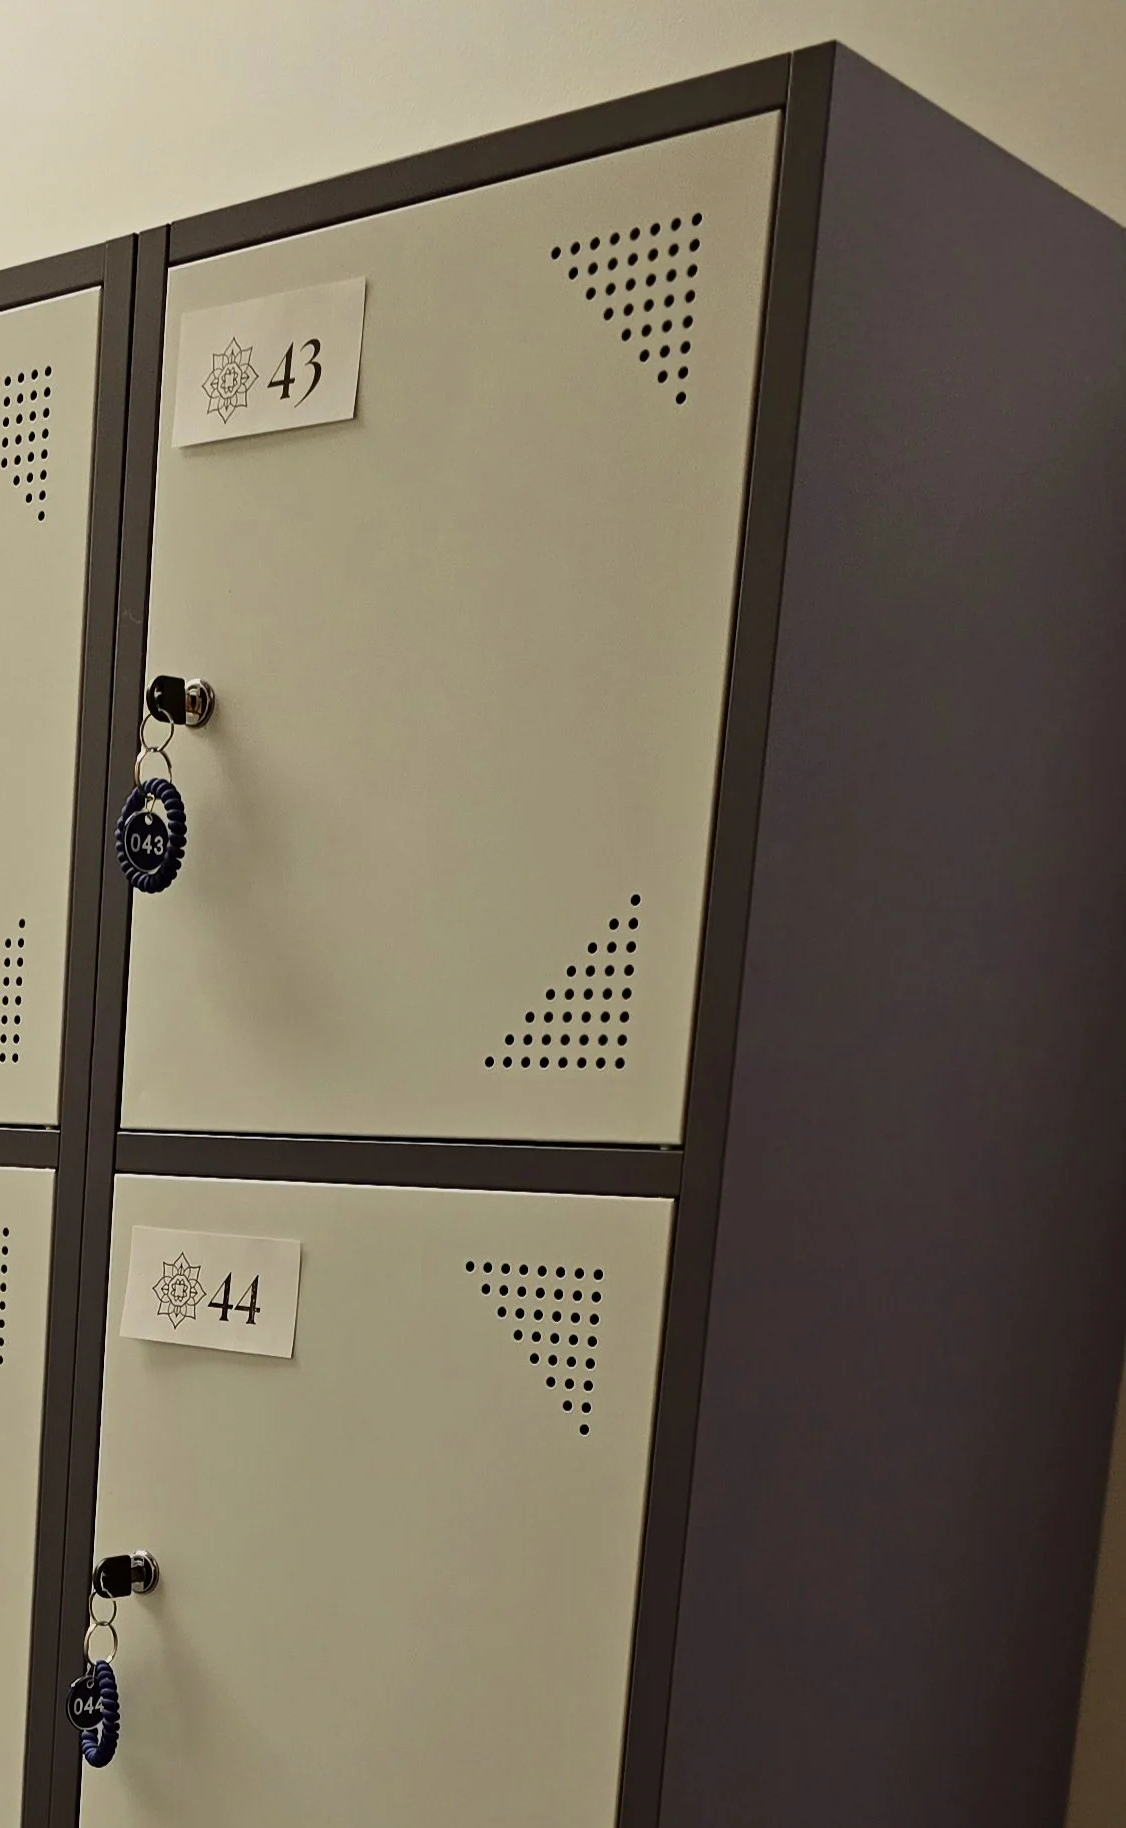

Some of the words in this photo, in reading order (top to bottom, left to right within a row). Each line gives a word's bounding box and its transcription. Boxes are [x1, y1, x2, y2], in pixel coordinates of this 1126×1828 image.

[267, 338, 322, 408] 43
[130, 833, 165, 856] 043
[207, 1271, 261, 1326] 44
